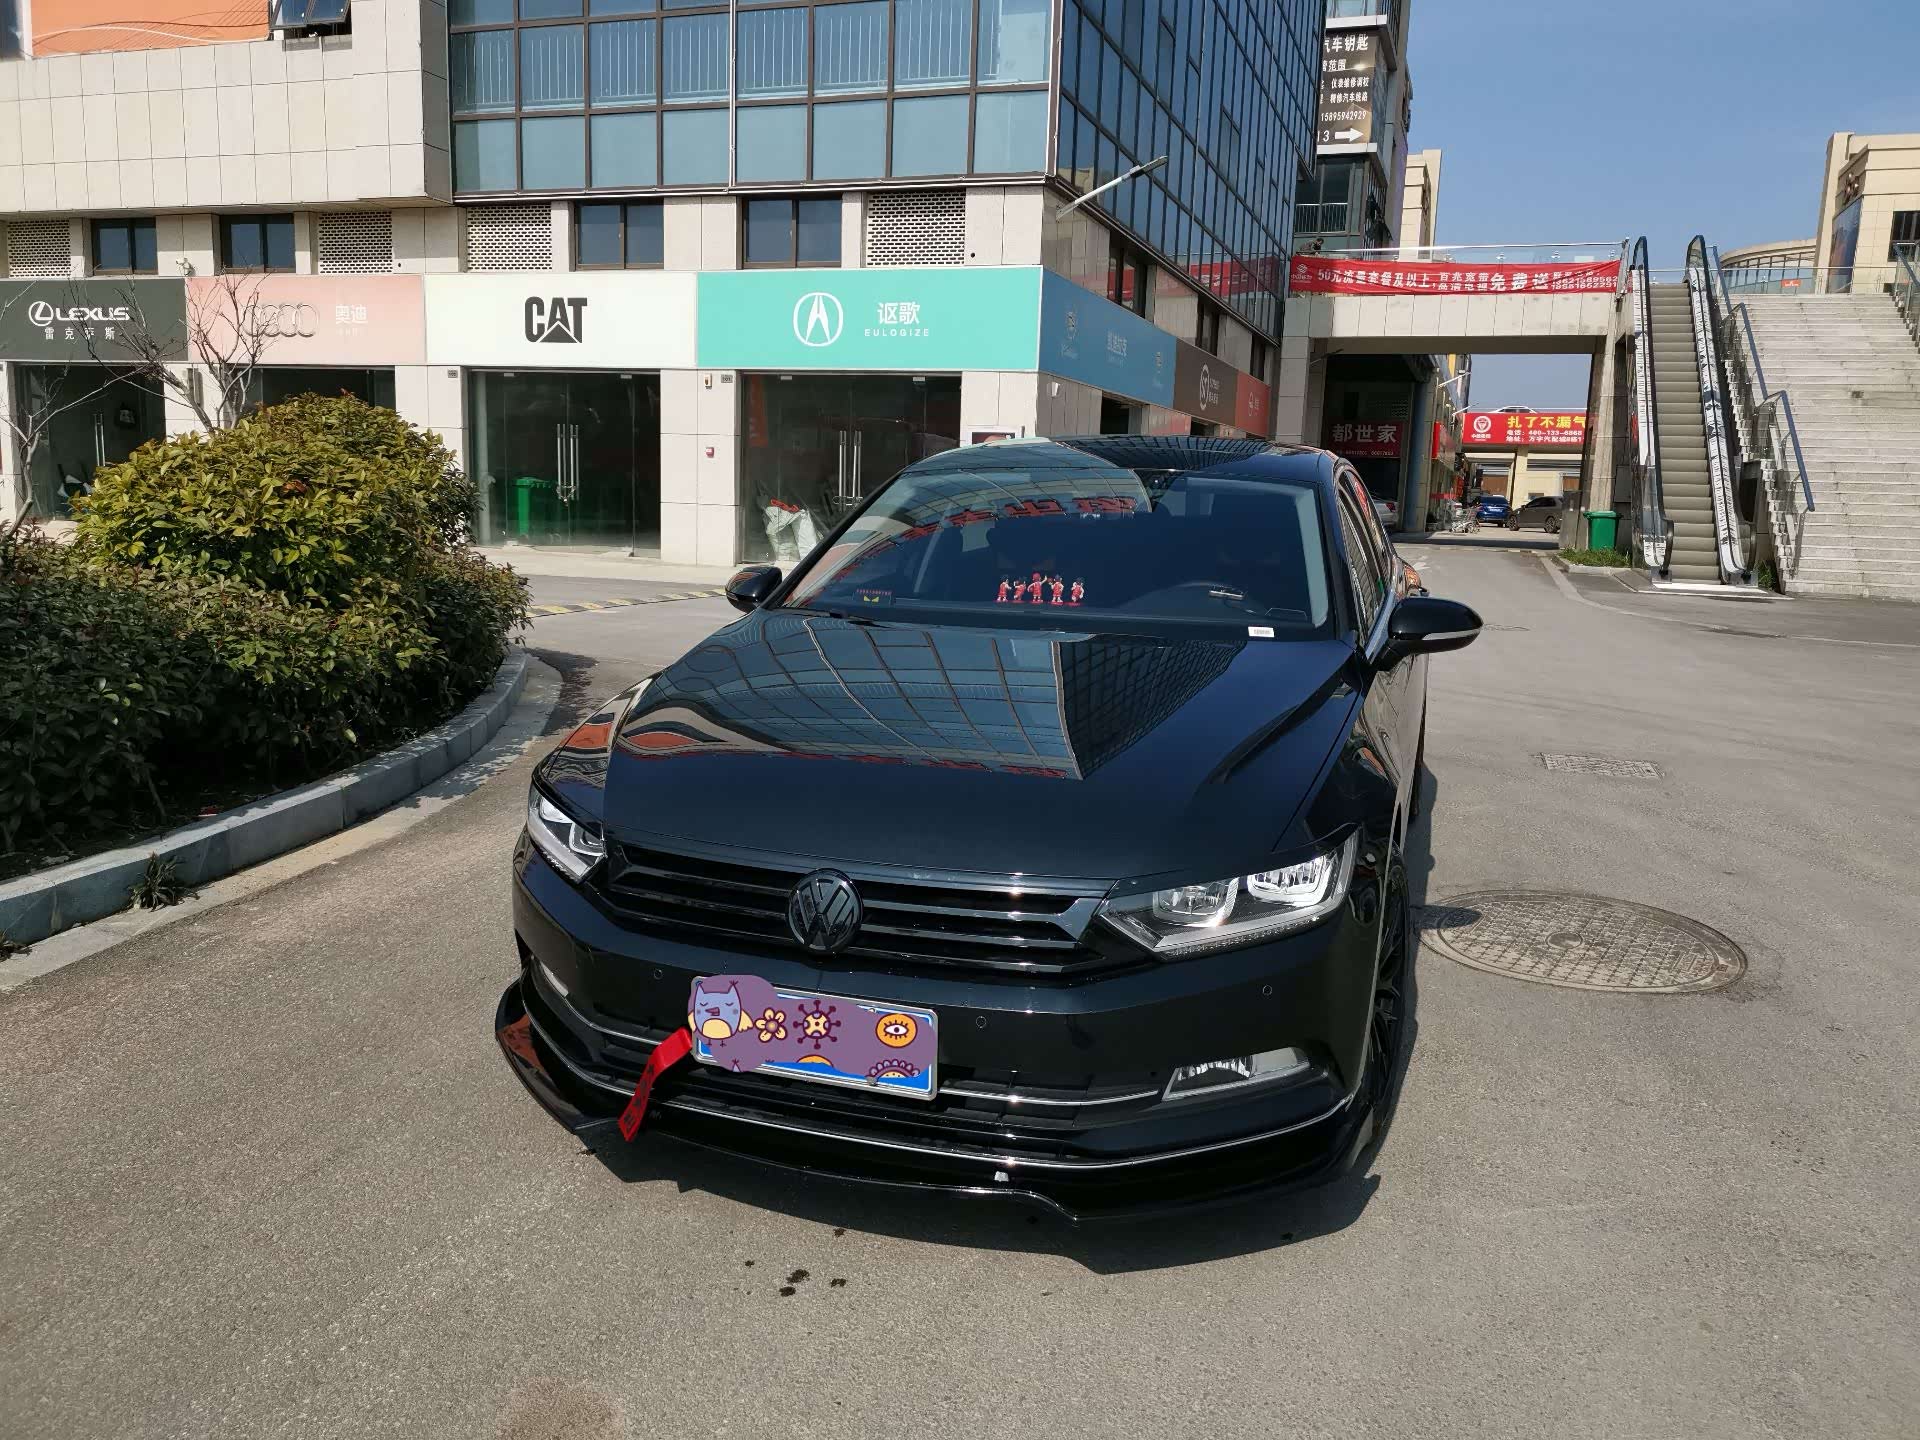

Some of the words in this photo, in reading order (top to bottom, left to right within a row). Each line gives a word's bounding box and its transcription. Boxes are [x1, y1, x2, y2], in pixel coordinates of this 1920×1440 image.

[55, 307, 130, 321] LEXUS
[336, 304, 368, 325] 奥迪
[525, 296, 588, 343] CAT
[877, 301, 920, 325] 讴歌
[864, 328, 929, 337] EULOGIZE
[1507, 415, 1586, 428] 扎了不漏气
[1332, 423, 1397, 443] 都世家
